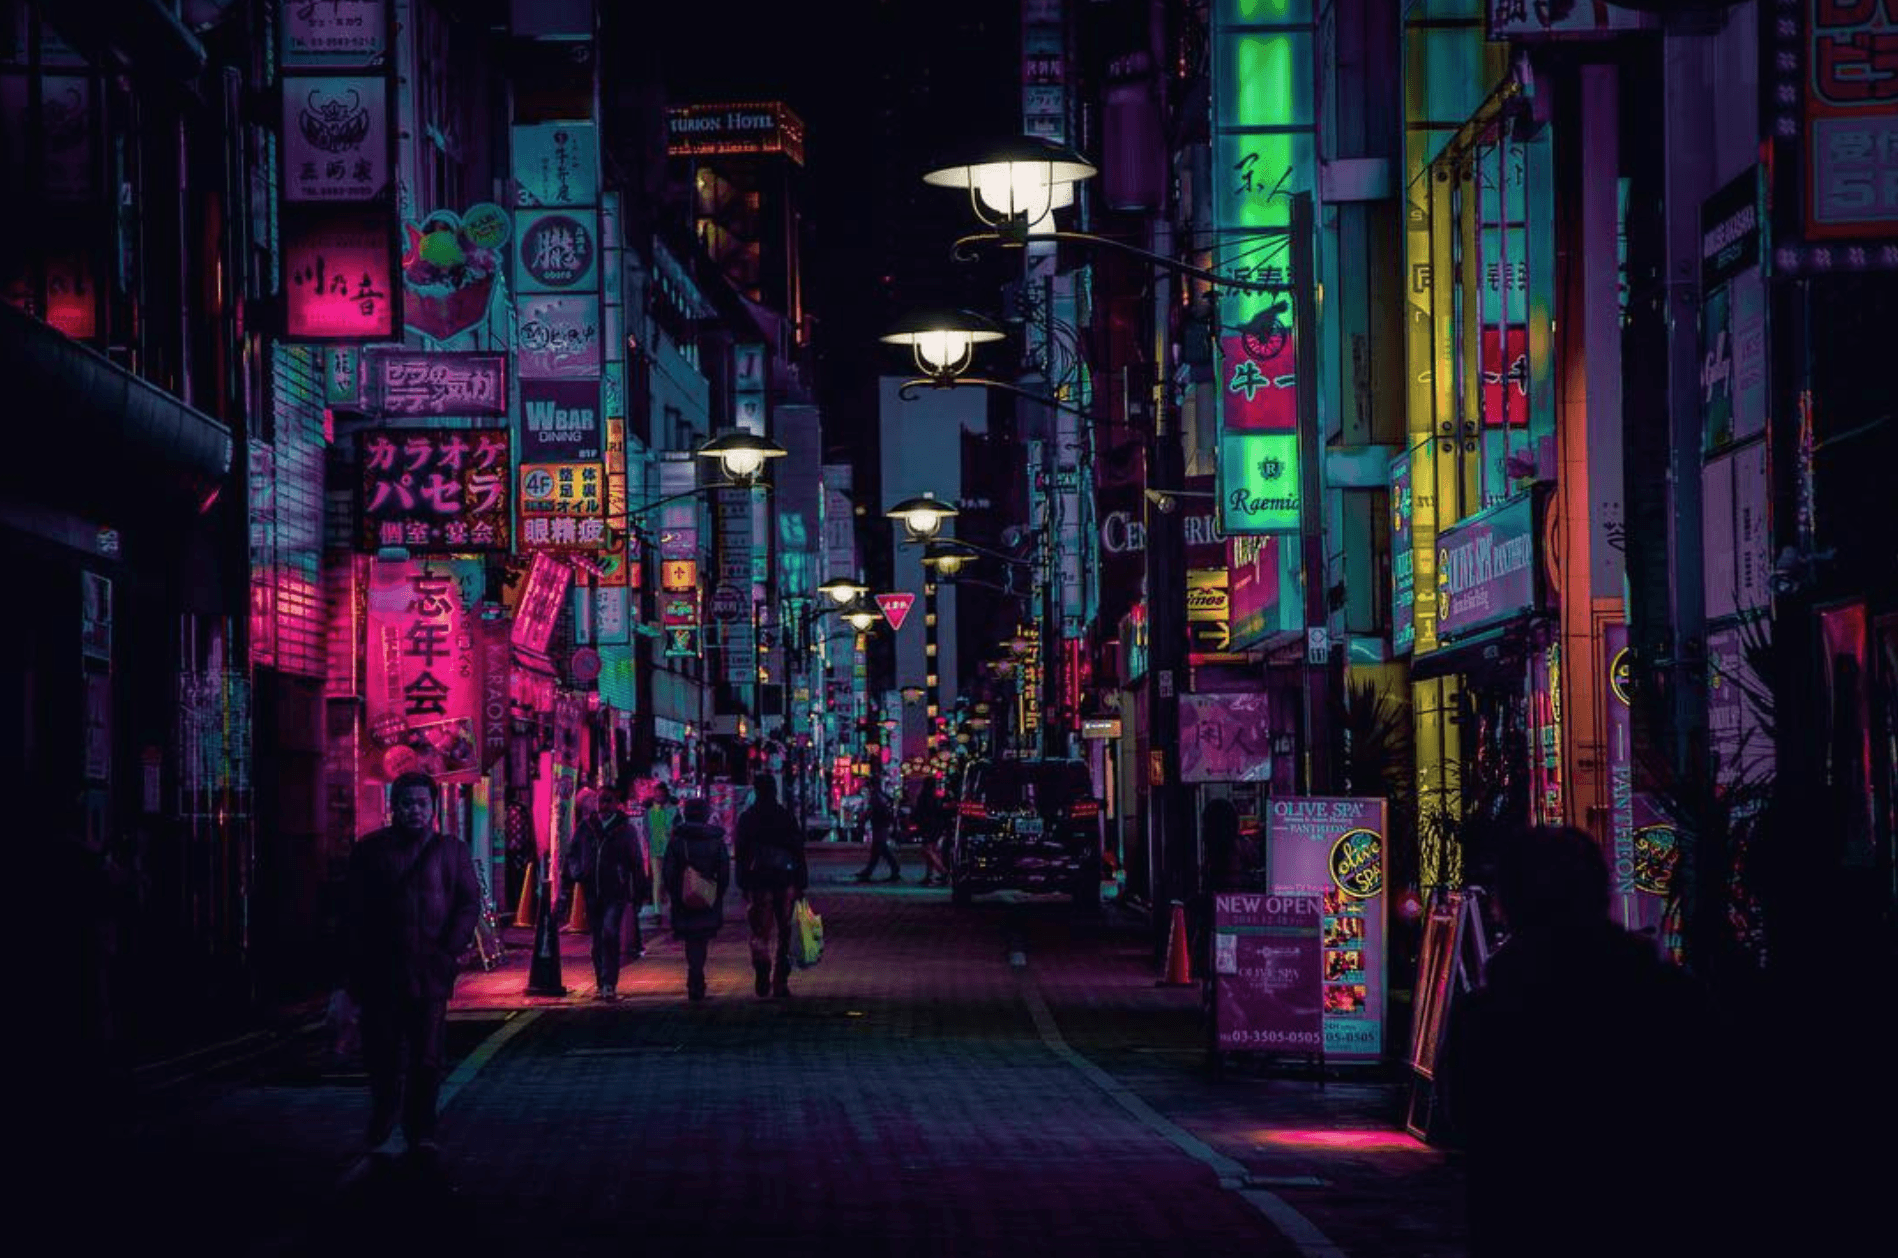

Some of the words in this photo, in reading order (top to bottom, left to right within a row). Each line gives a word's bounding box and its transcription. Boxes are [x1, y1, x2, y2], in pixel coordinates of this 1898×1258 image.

[366, 436, 505, 470] カラオケ
[366, 473, 502, 514] パセラ
[526, 473, 550, 494] 4F
[404, 570, 453, 716] 忘年会
[1274, 801, 1328, 816] OLIVE
[1333, 802, 1363, 818] SPA
[1612, 765, 1634, 892] PANTHEON
[1216, 896, 1260, 914] NEW
[1265, 897, 1319, 914] OPEN
